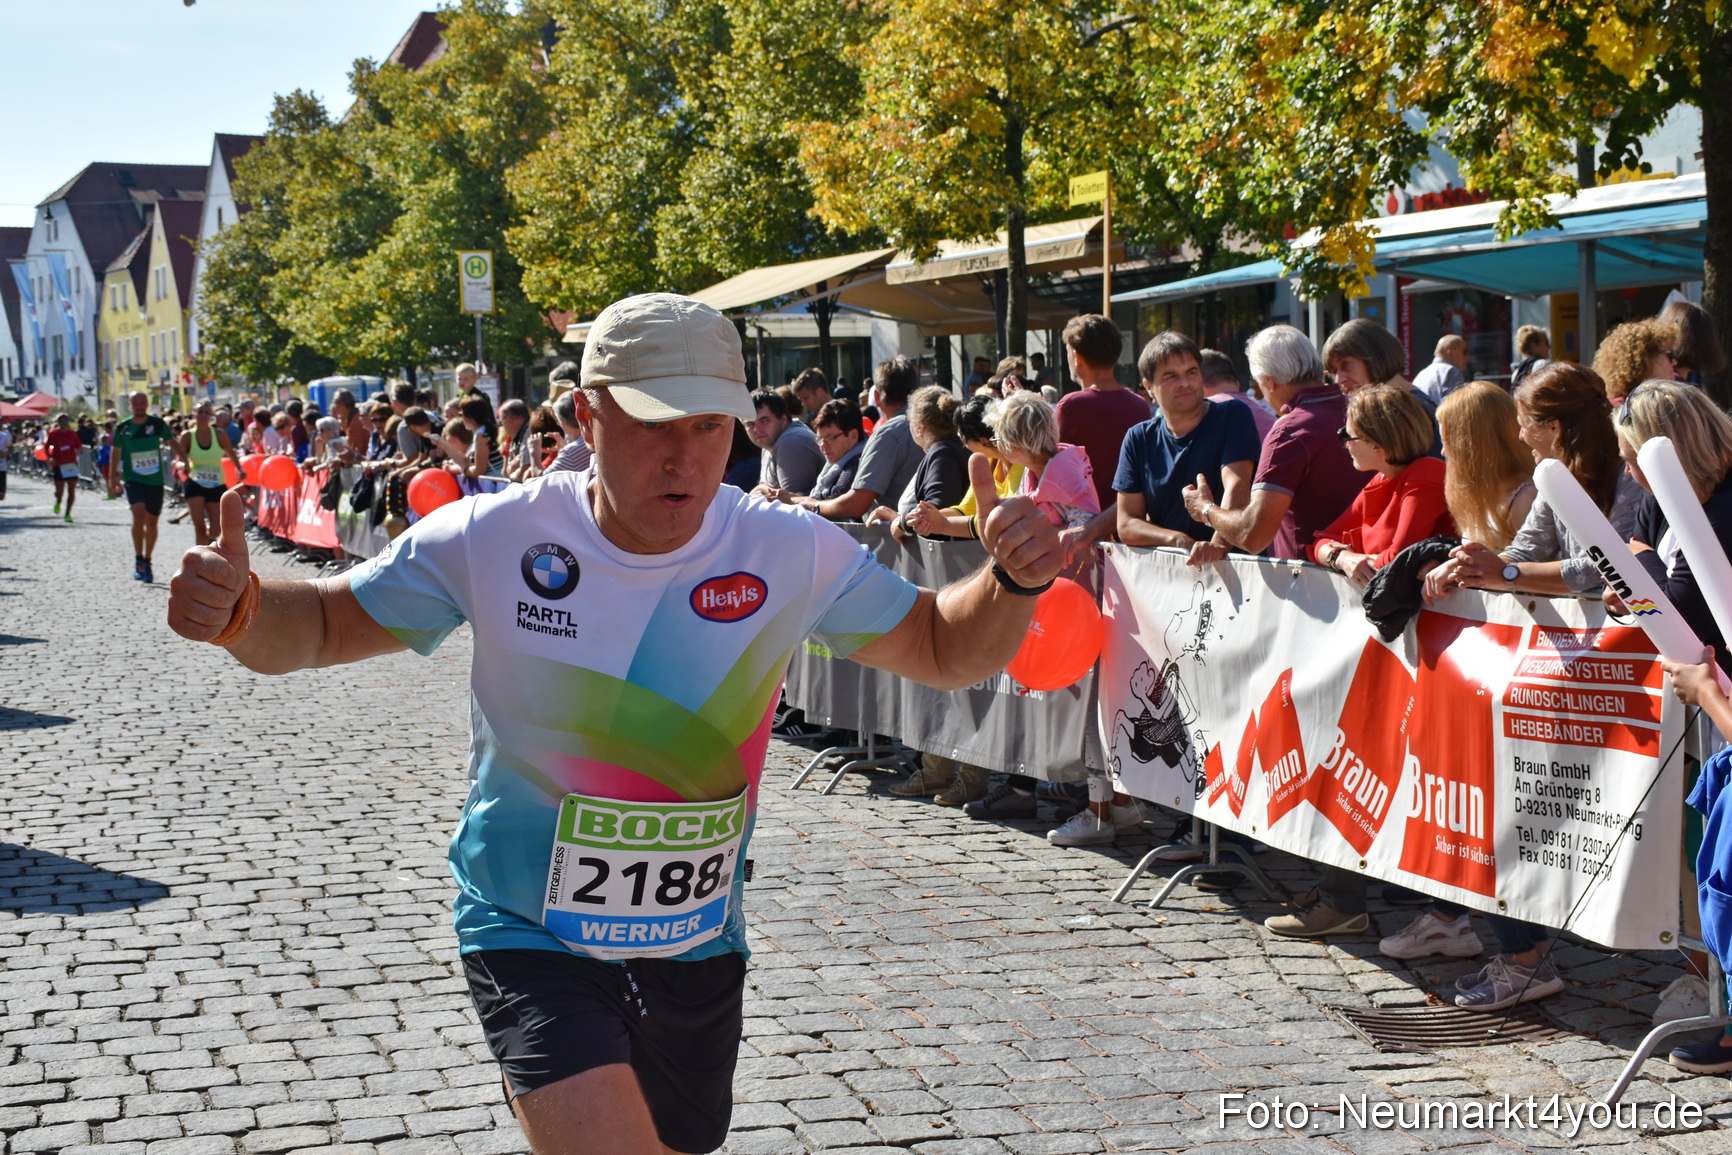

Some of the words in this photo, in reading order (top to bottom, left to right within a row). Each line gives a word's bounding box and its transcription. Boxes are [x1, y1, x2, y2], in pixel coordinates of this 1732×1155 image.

[1077, 182, 1105, 196] Toiletten
[1413, 183, 1491, 213] vodao
[528, 544, 577, 567] BMW
[1586, 545, 1633, 600] swn
[701, 585, 759, 608] Hervis
[516, 616, 578, 639] Neumarkt
[517, 601, 578, 627] PARTL
[1521, 659, 1635, 681] VERZURRSYSTEME
[1510, 687, 1626, 714] RUNDSCHLINGEN
[1511, 718, 1605, 744] HEBEBÄNDER
[1264, 748, 1302, 804] Braun
[1319, 725, 1389, 820] Braun
[1514, 756, 1547, 776] Braun
[1551, 761, 1591, 780] GmbH
[1407, 753, 1484, 839] Braun
[1514, 777, 1532, 794] Am
[1535, 780, 1592, 806] Grünberg
[1595, 787, 1601, 803] 8
[575, 804, 741, 845] BOCK
[1336, 791, 1353, 815] Sicher
[1351, 809, 1362, 823] ist
[1359, 819, 1378, 840] sicher
[1514, 797, 1562, 819] D-92318
[1565, 803, 1643, 841] Neumarkt-Png
[1435, 834, 1456, 856] Sicher
[1459, 842, 1470, 859] ist
[1470, 846, 1496, 866] sicher
[1516, 826, 1539, 843] Tel.
[1541, 829, 1572, 851] 09181
[1519, 846, 1539, 865] Fax
[1542, 850, 1572, 870] 09181
[572, 853, 725, 906] 2188
[581, 914, 702, 942] WERNER
